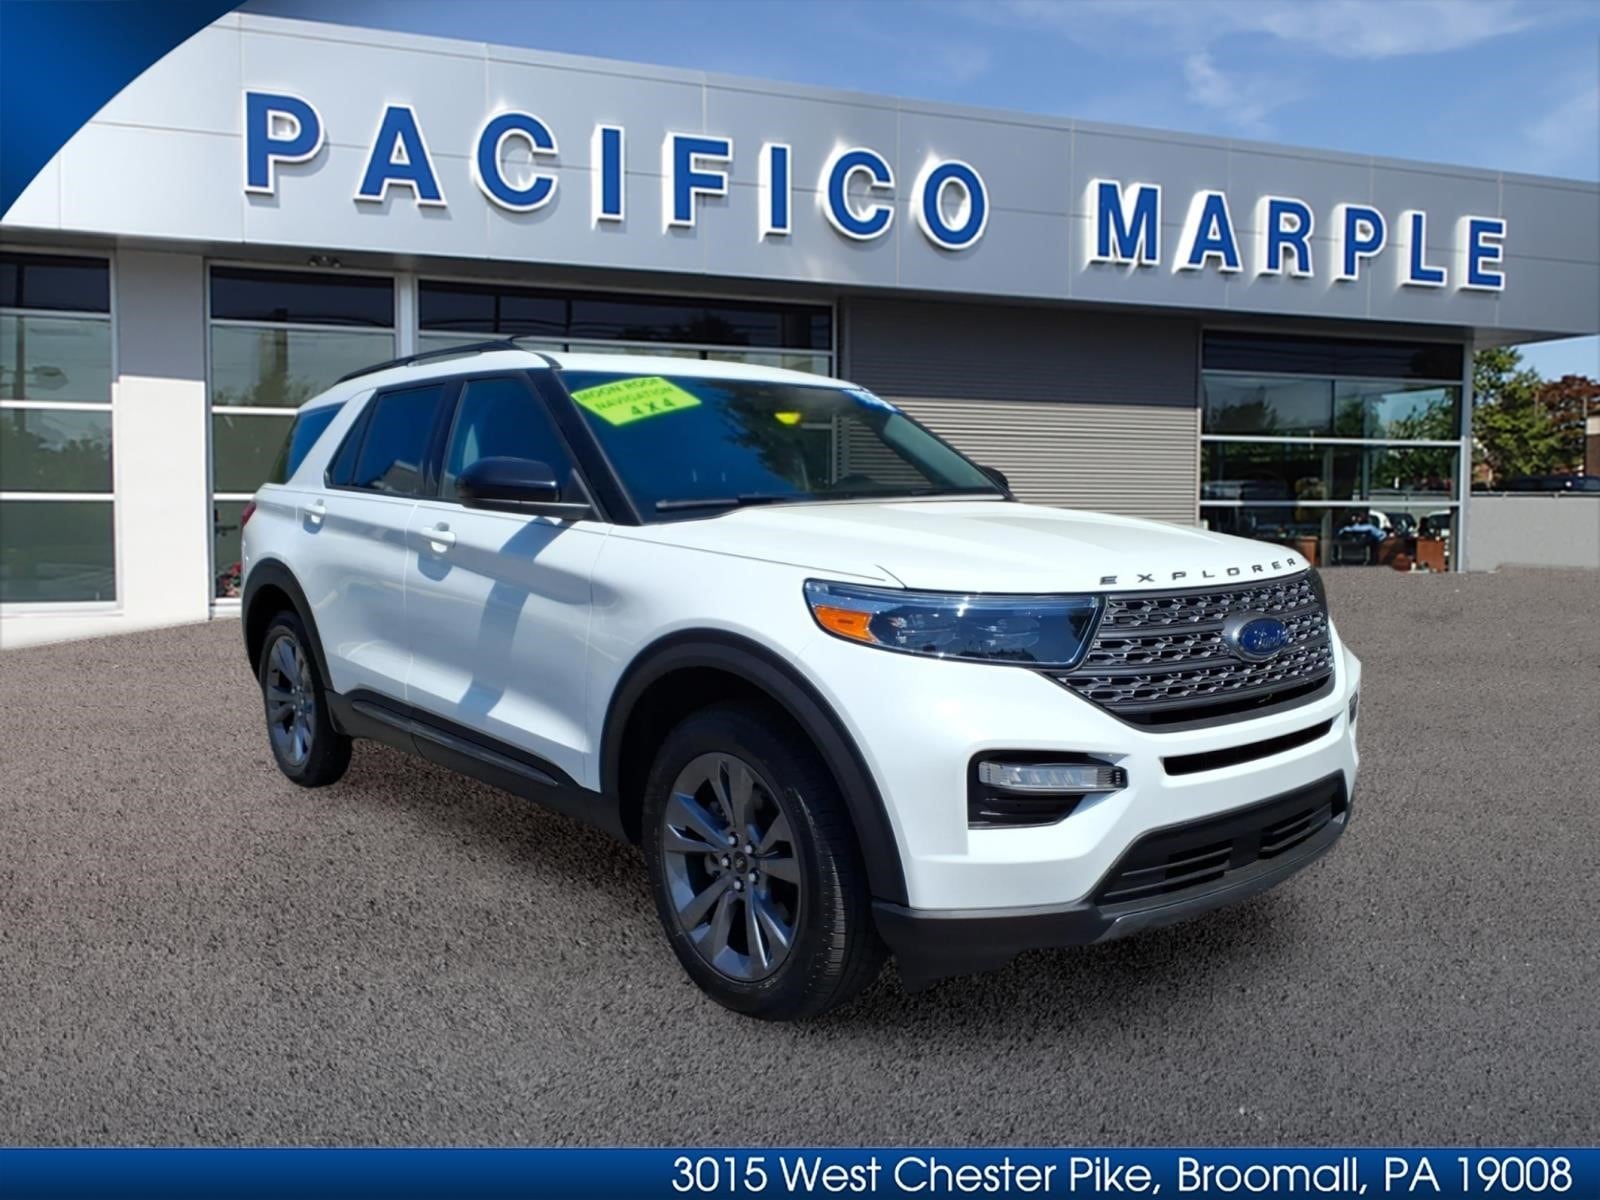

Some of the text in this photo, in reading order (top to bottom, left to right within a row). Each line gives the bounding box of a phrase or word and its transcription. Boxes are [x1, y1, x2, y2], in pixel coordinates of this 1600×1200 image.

[242, 88, 1507, 293] PACIFICO MARPLE
[1099, 557, 1297, 586] EXPLORER
